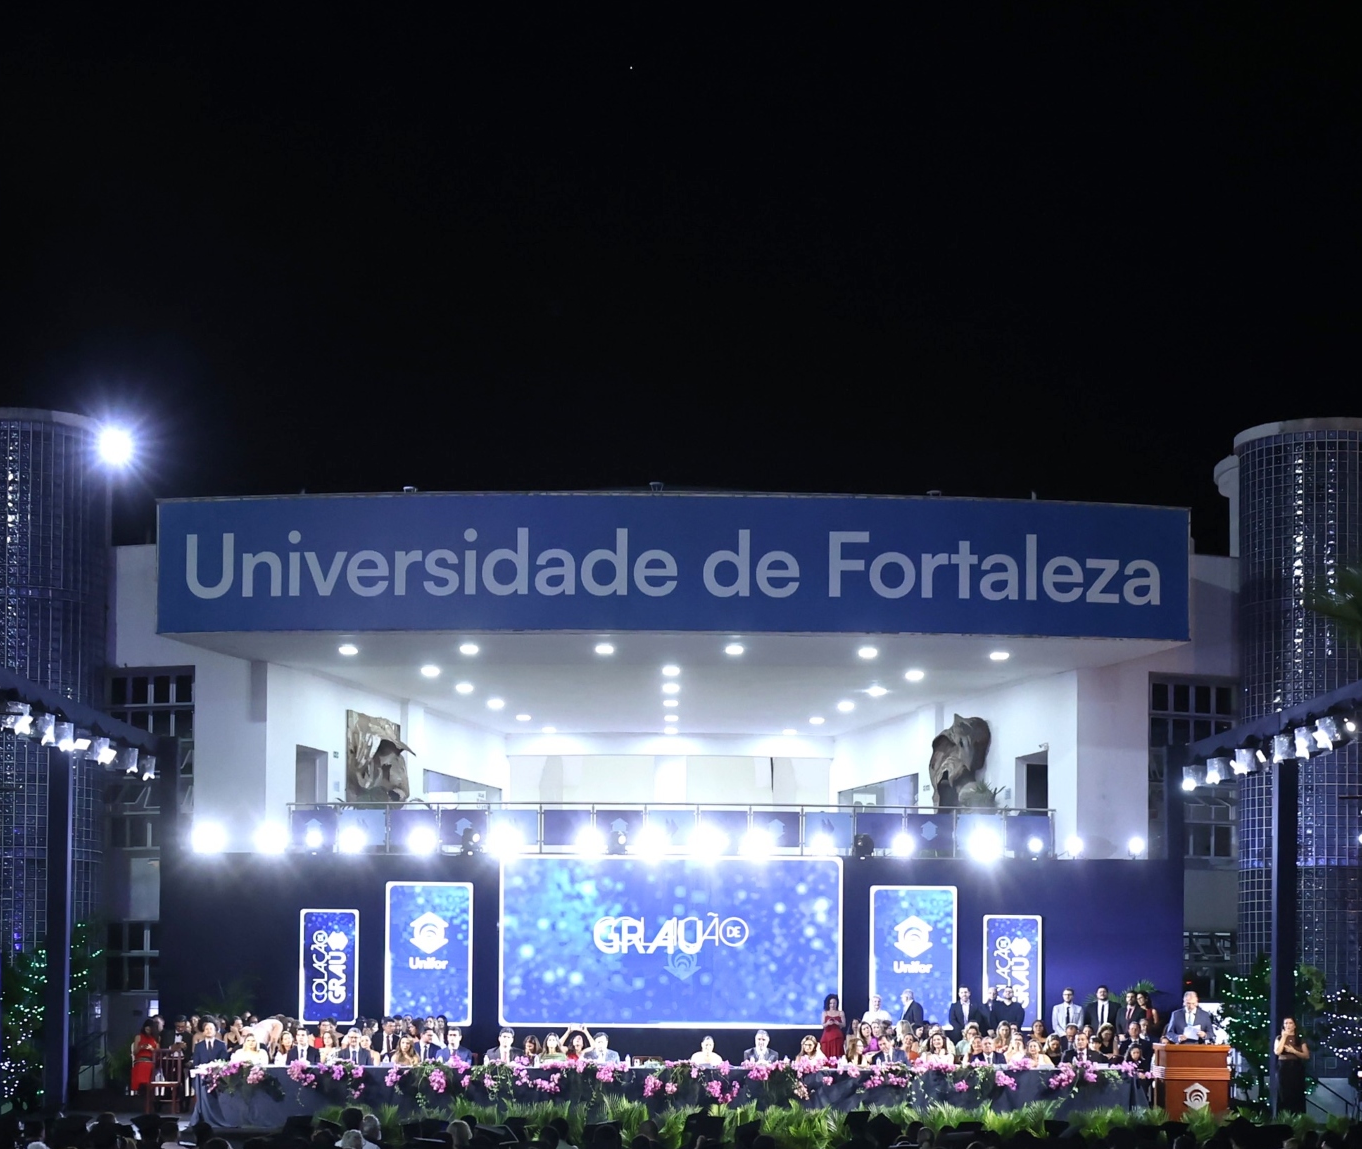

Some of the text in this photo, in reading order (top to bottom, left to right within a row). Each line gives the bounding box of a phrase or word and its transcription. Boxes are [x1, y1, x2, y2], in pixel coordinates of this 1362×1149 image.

[185, 527, 1161, 606] Universidade de Fortaleza
[327, 951, 347, 1004] GRAU
[408, 956, 449, 970] Unifor
[893, 960, 933, 974] Unifor
